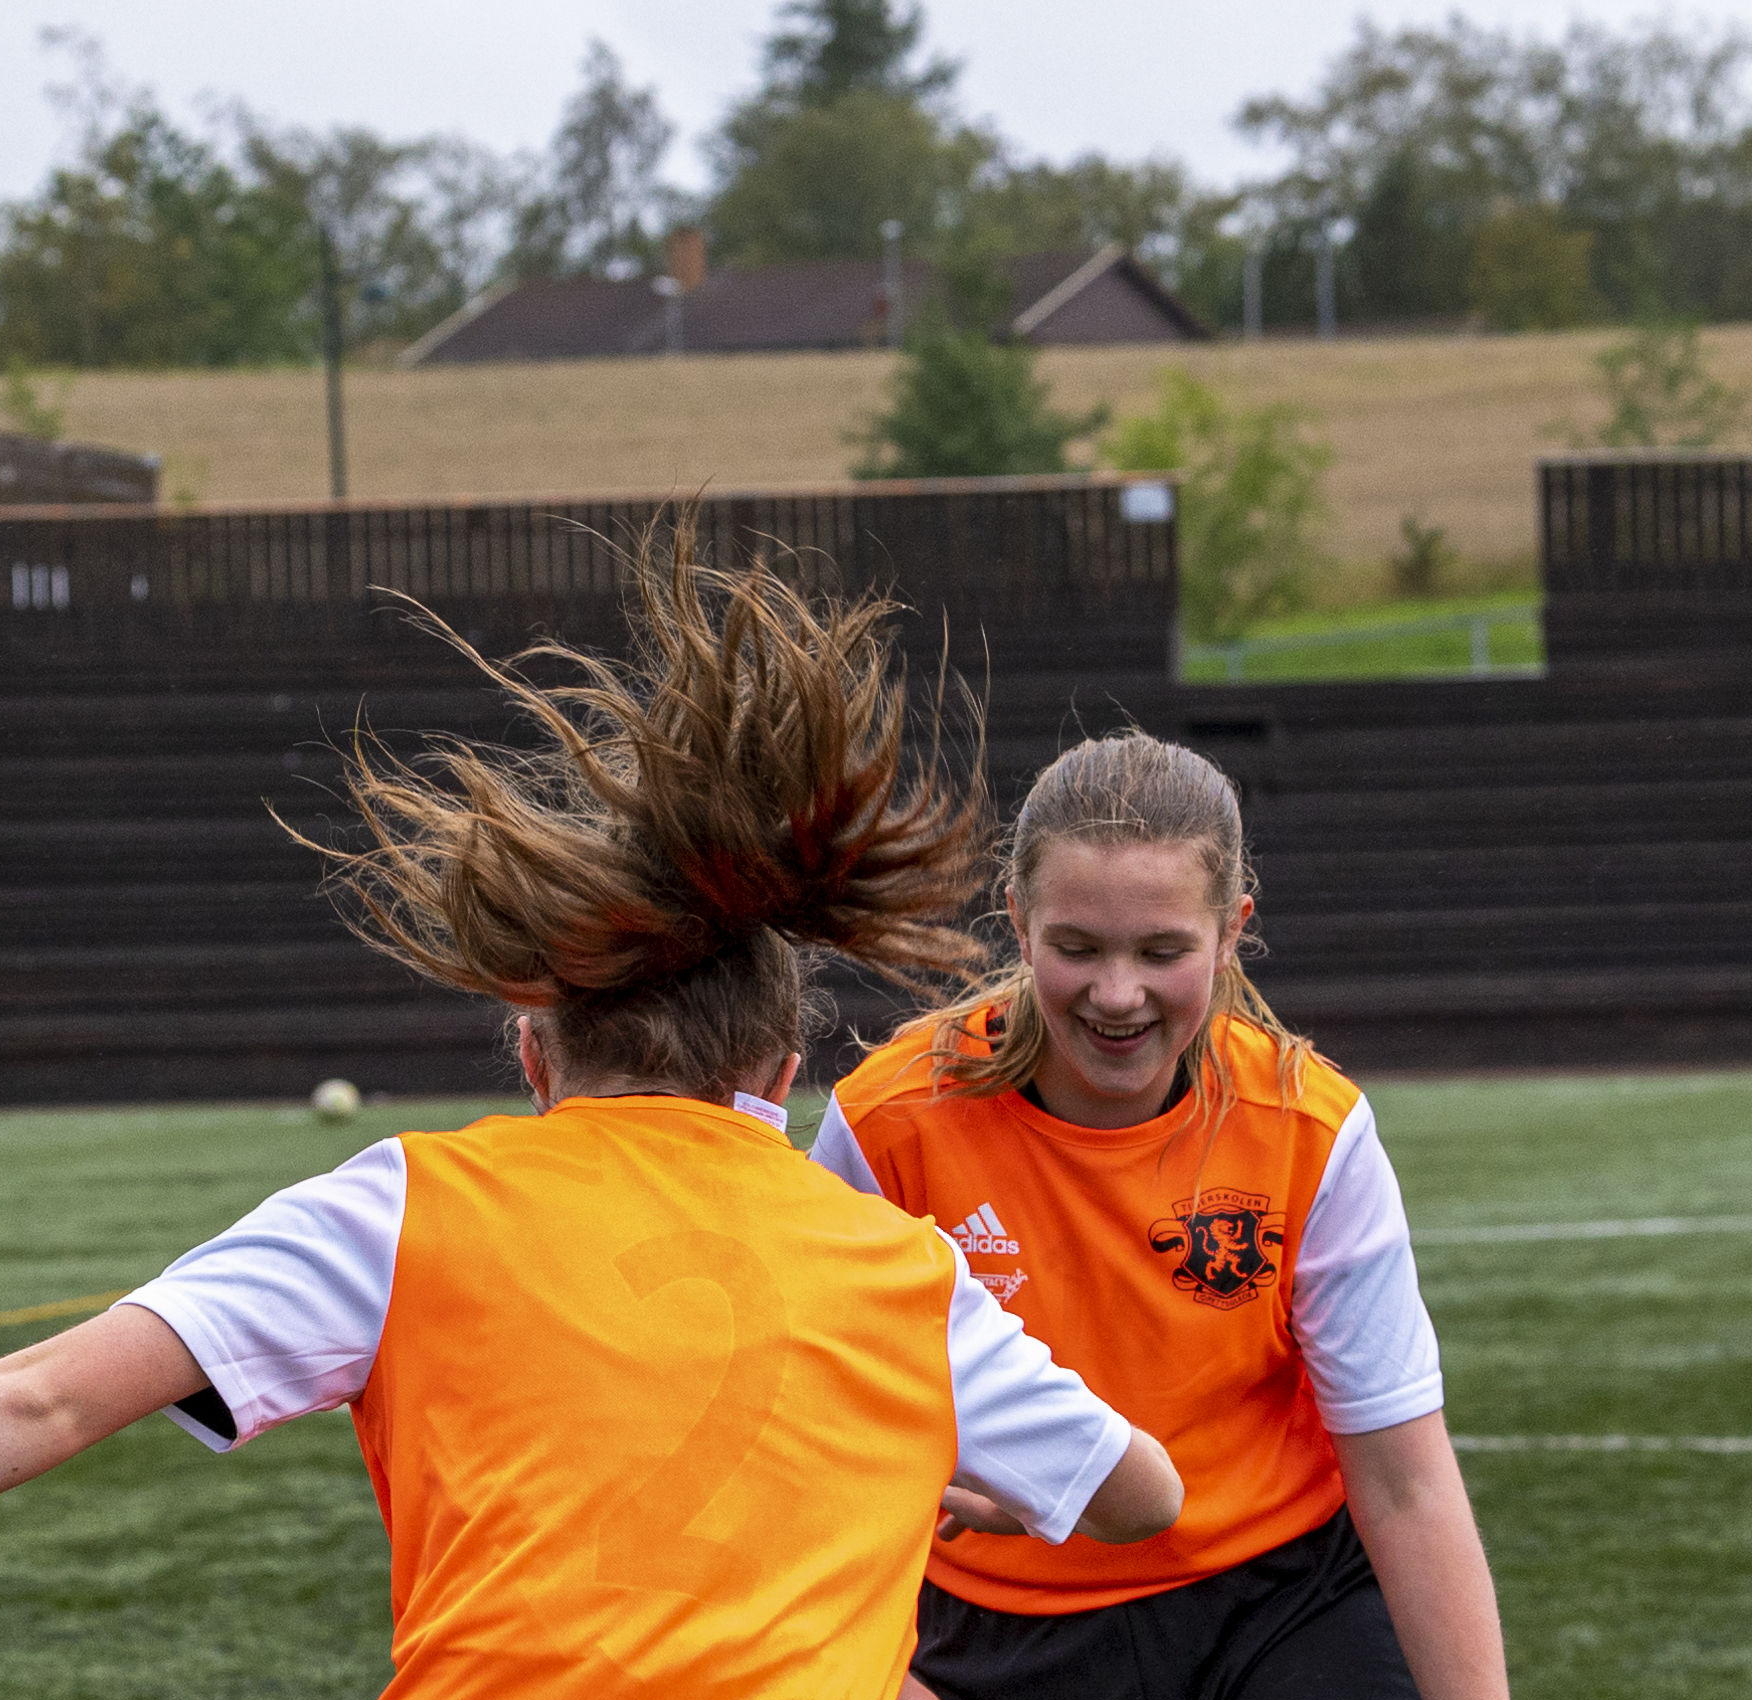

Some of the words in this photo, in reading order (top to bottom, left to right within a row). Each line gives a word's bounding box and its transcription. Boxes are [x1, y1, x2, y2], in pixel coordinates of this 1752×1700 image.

[1180, 1193, 1262, 1212] TIERSKOLEN
[954, 1234, 1020, 1255] didas
[594, 1229, 790, 1604] 2
